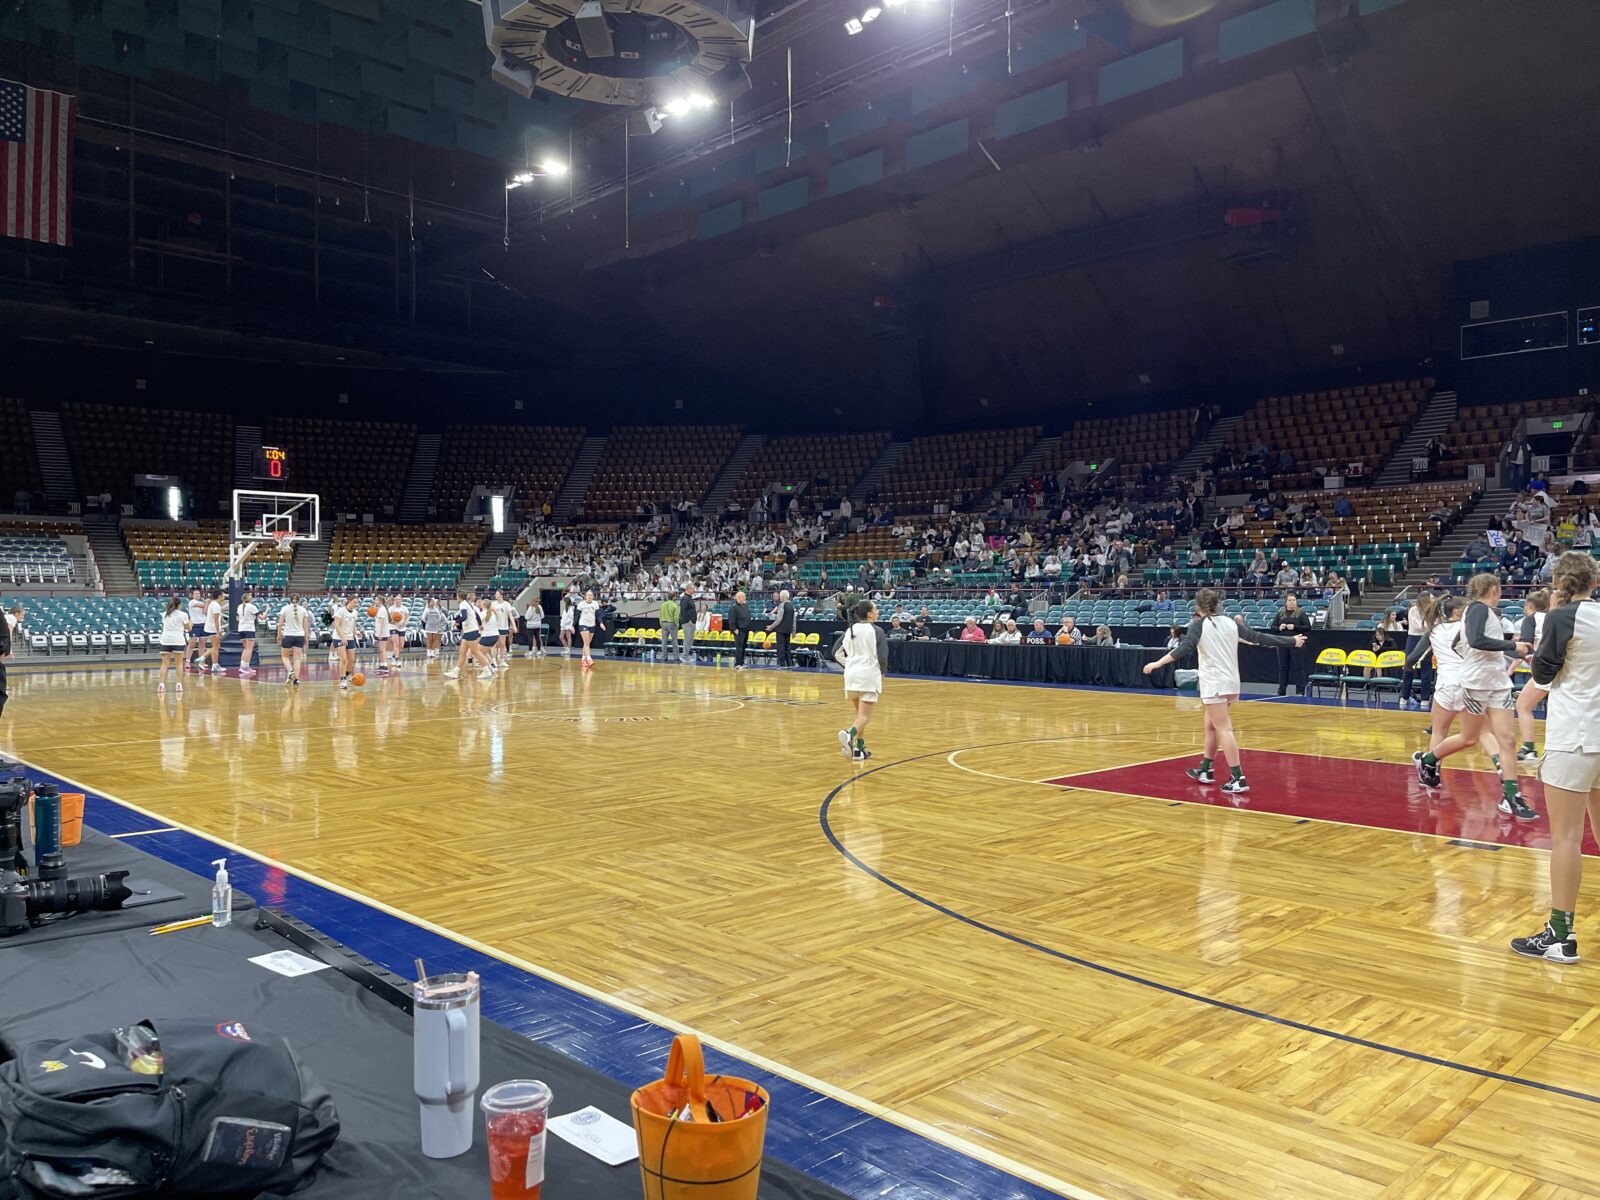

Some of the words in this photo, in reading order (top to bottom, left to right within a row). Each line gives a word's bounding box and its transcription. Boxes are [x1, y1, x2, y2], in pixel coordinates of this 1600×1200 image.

[266, 450, 285, 460] 1:04
[271, 460, 281, 477] 0
[1026, 637, 1046, 645] POSS.
